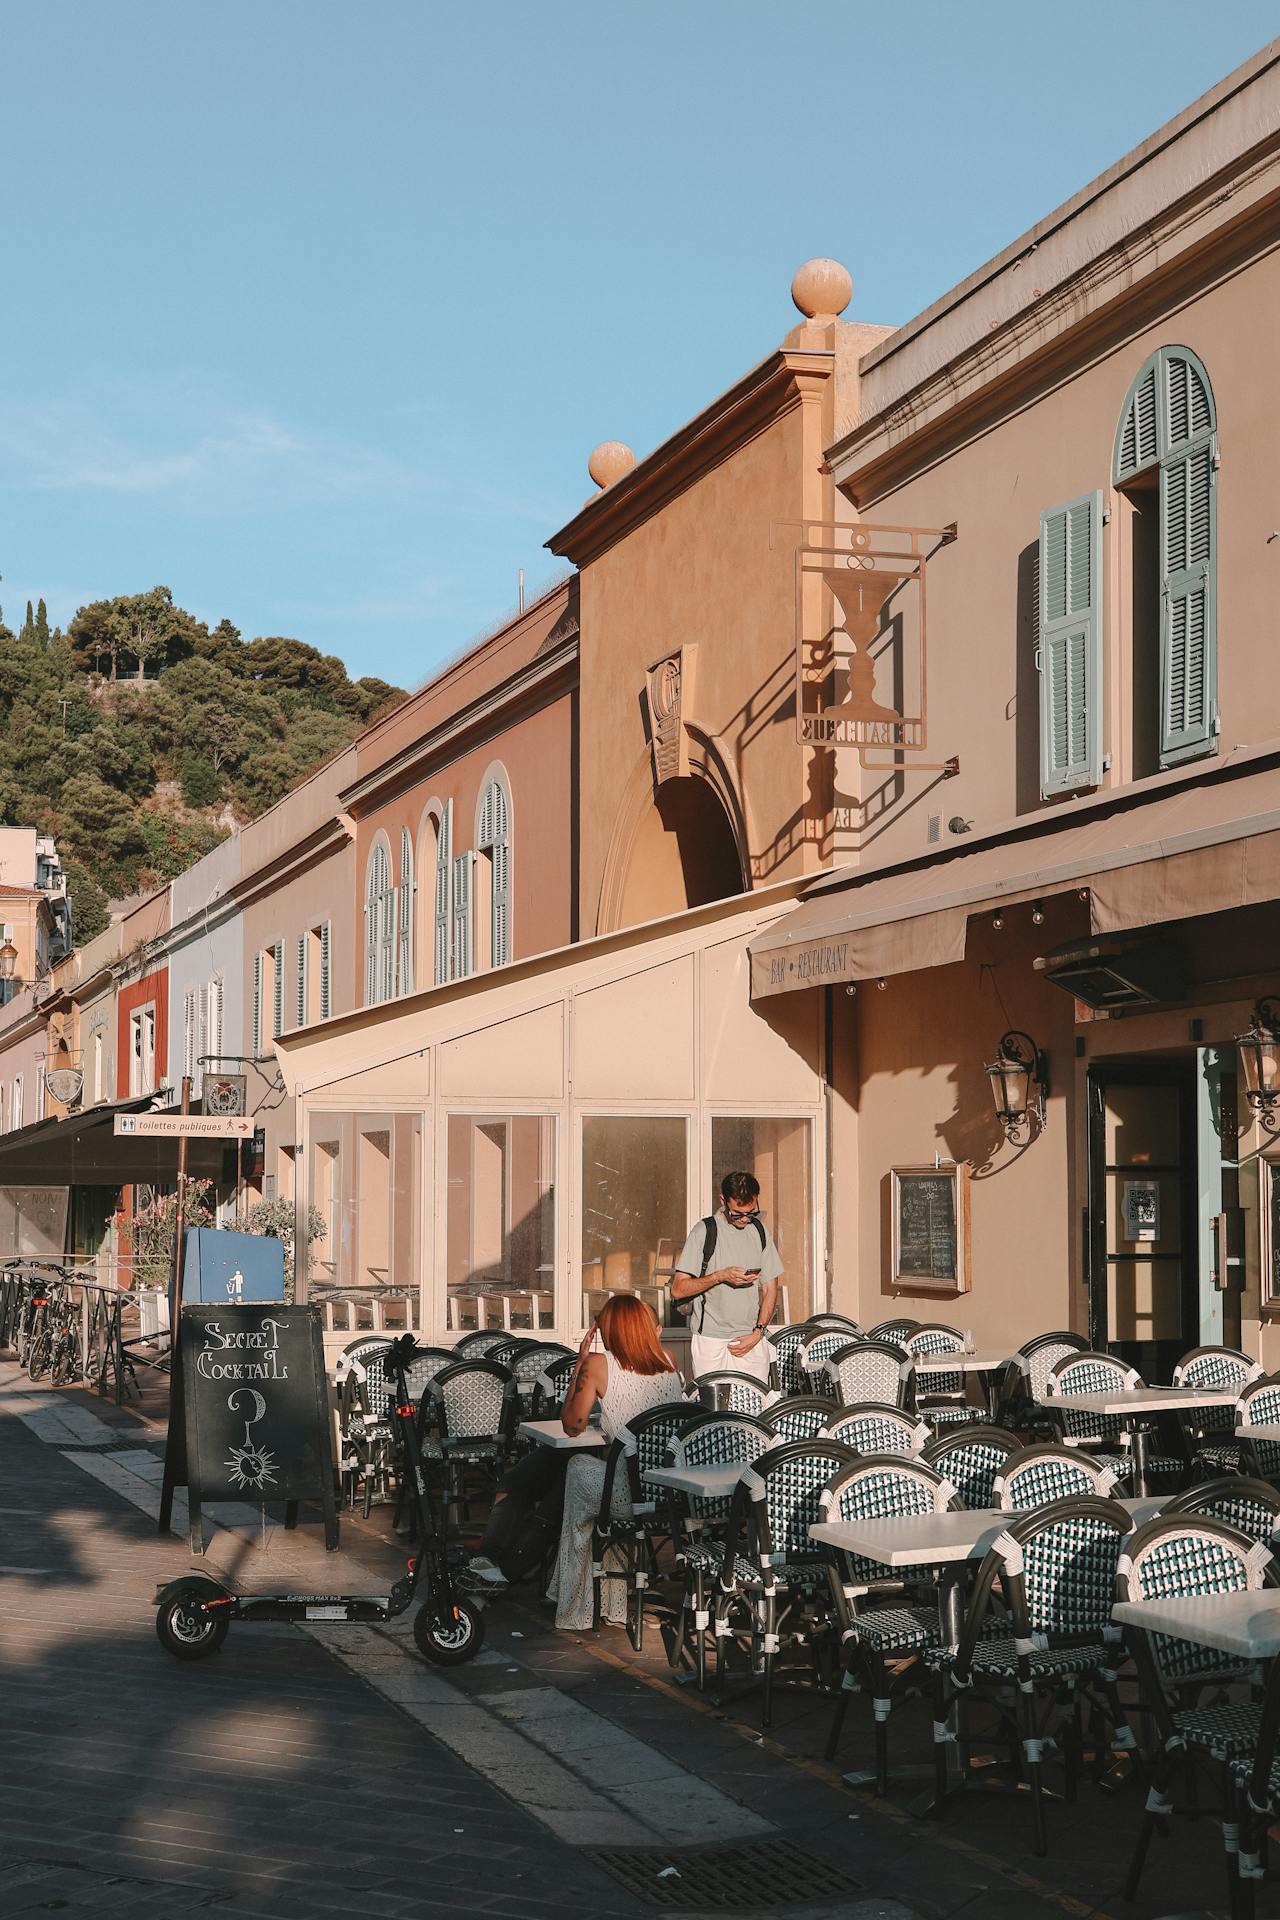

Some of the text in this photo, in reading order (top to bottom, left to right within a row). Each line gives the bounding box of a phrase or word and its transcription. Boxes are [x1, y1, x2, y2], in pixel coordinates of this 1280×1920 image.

[770, 943, 849, 985] BAR RESTAURANT
[139, 1121, 222, 1133] toilettes publiques
[204, 1318, 290, 1350] SECRET
[197, 1349, 289, 1380] COCKTAIL
